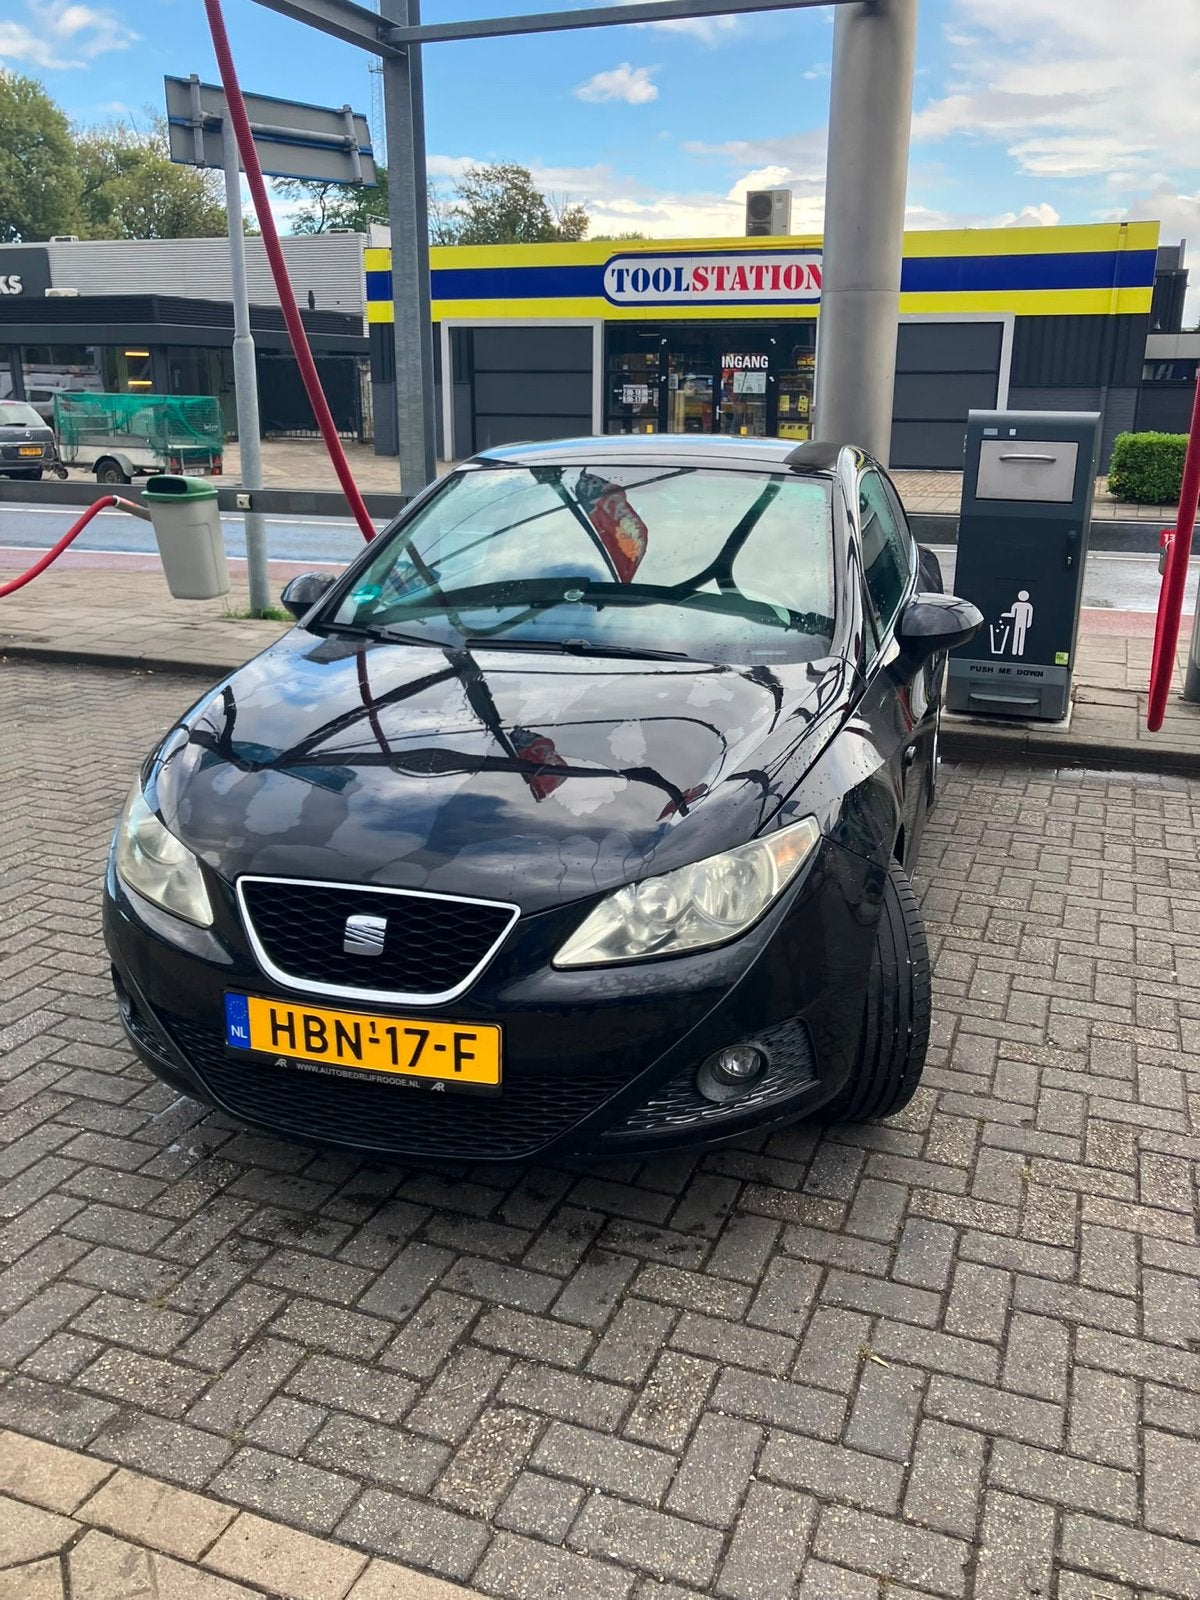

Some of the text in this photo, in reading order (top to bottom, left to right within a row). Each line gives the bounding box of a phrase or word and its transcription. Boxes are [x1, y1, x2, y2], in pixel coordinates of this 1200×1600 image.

[721, 355, 769, 369] INGANG
[970, 665, 1044, 677] PUSH ME DOWN
[231, 1024, 248, 1039] NL
